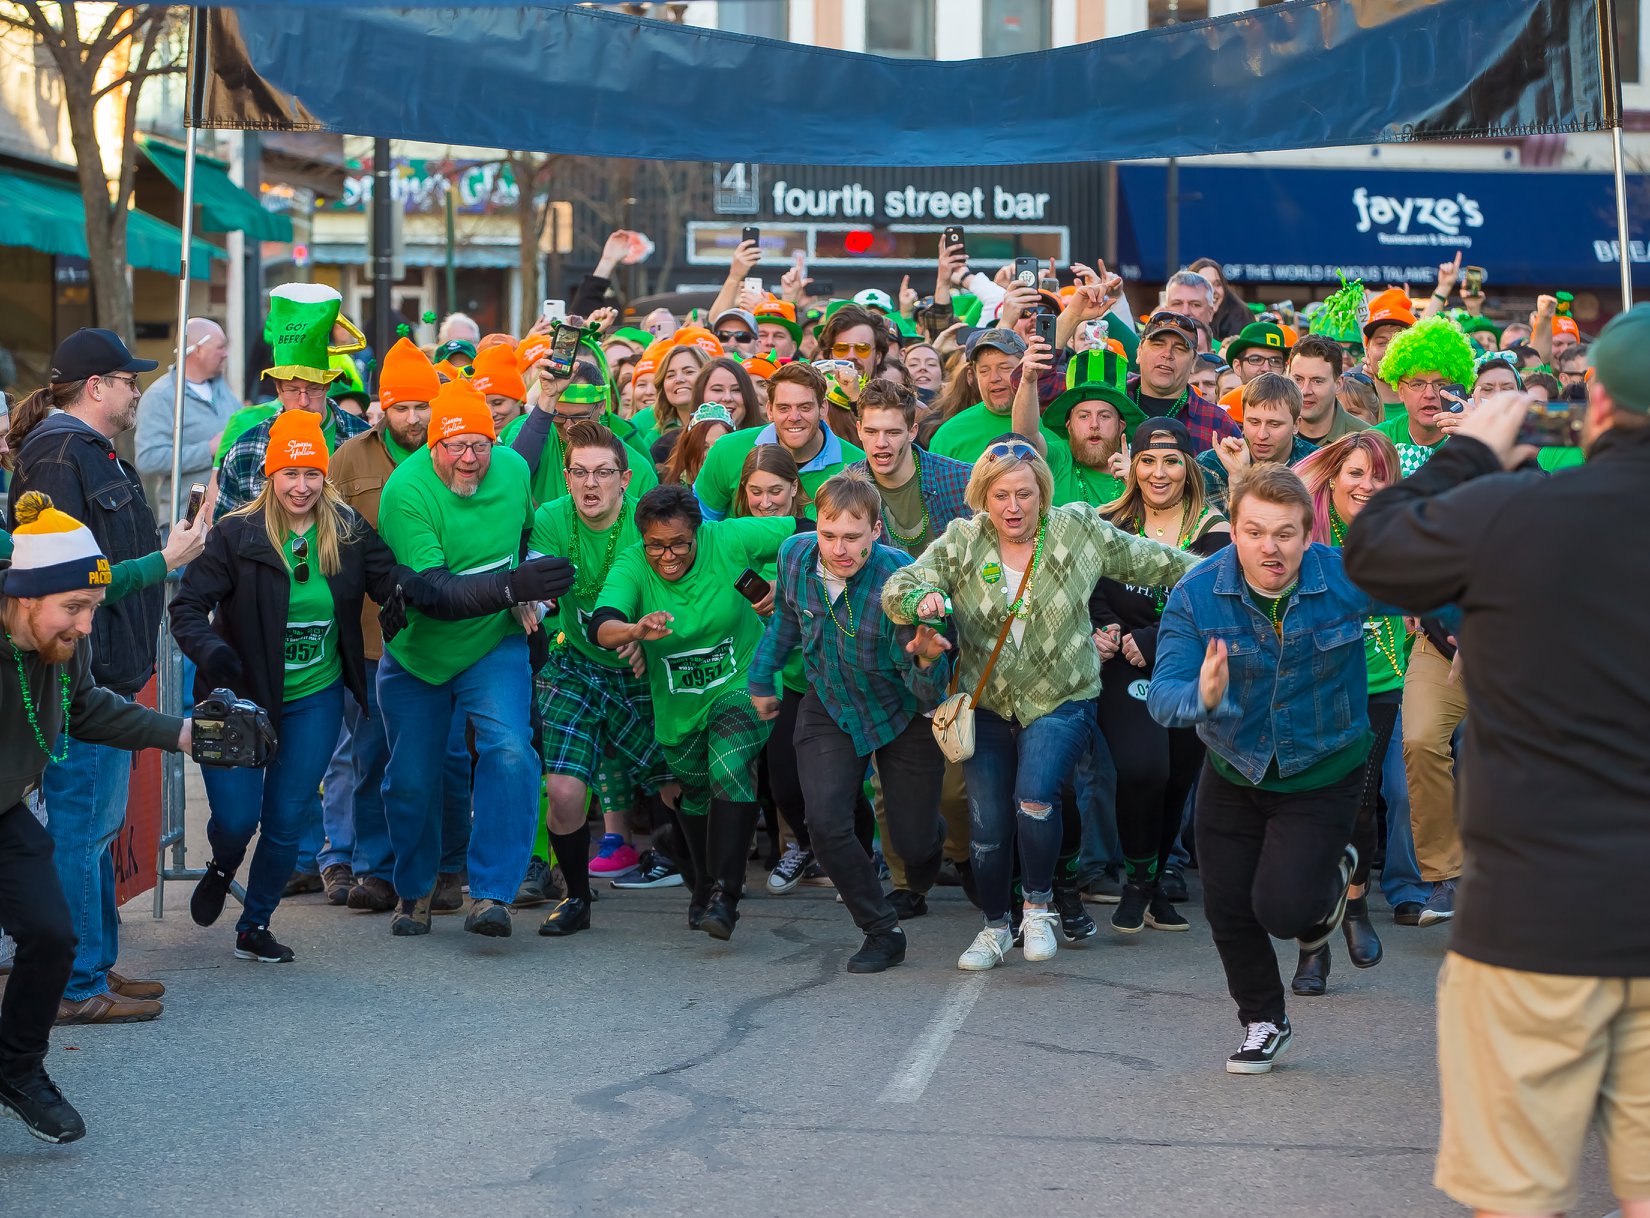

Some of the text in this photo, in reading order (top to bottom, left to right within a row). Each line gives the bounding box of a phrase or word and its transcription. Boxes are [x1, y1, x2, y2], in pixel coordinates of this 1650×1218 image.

[721, 162, 746, 193] 4
[774, 181, 1050, 220] fourth street bar
[1245, 263, 1272, 281] THE
[1273, 264, 1324, 282] WORLD
[285, 323, 308, 331] GOT
[278, 334, 306, 344] BEER?
[284, 440, 313, 452] Sleepy
[290, 448, 316, 460] Hollow
